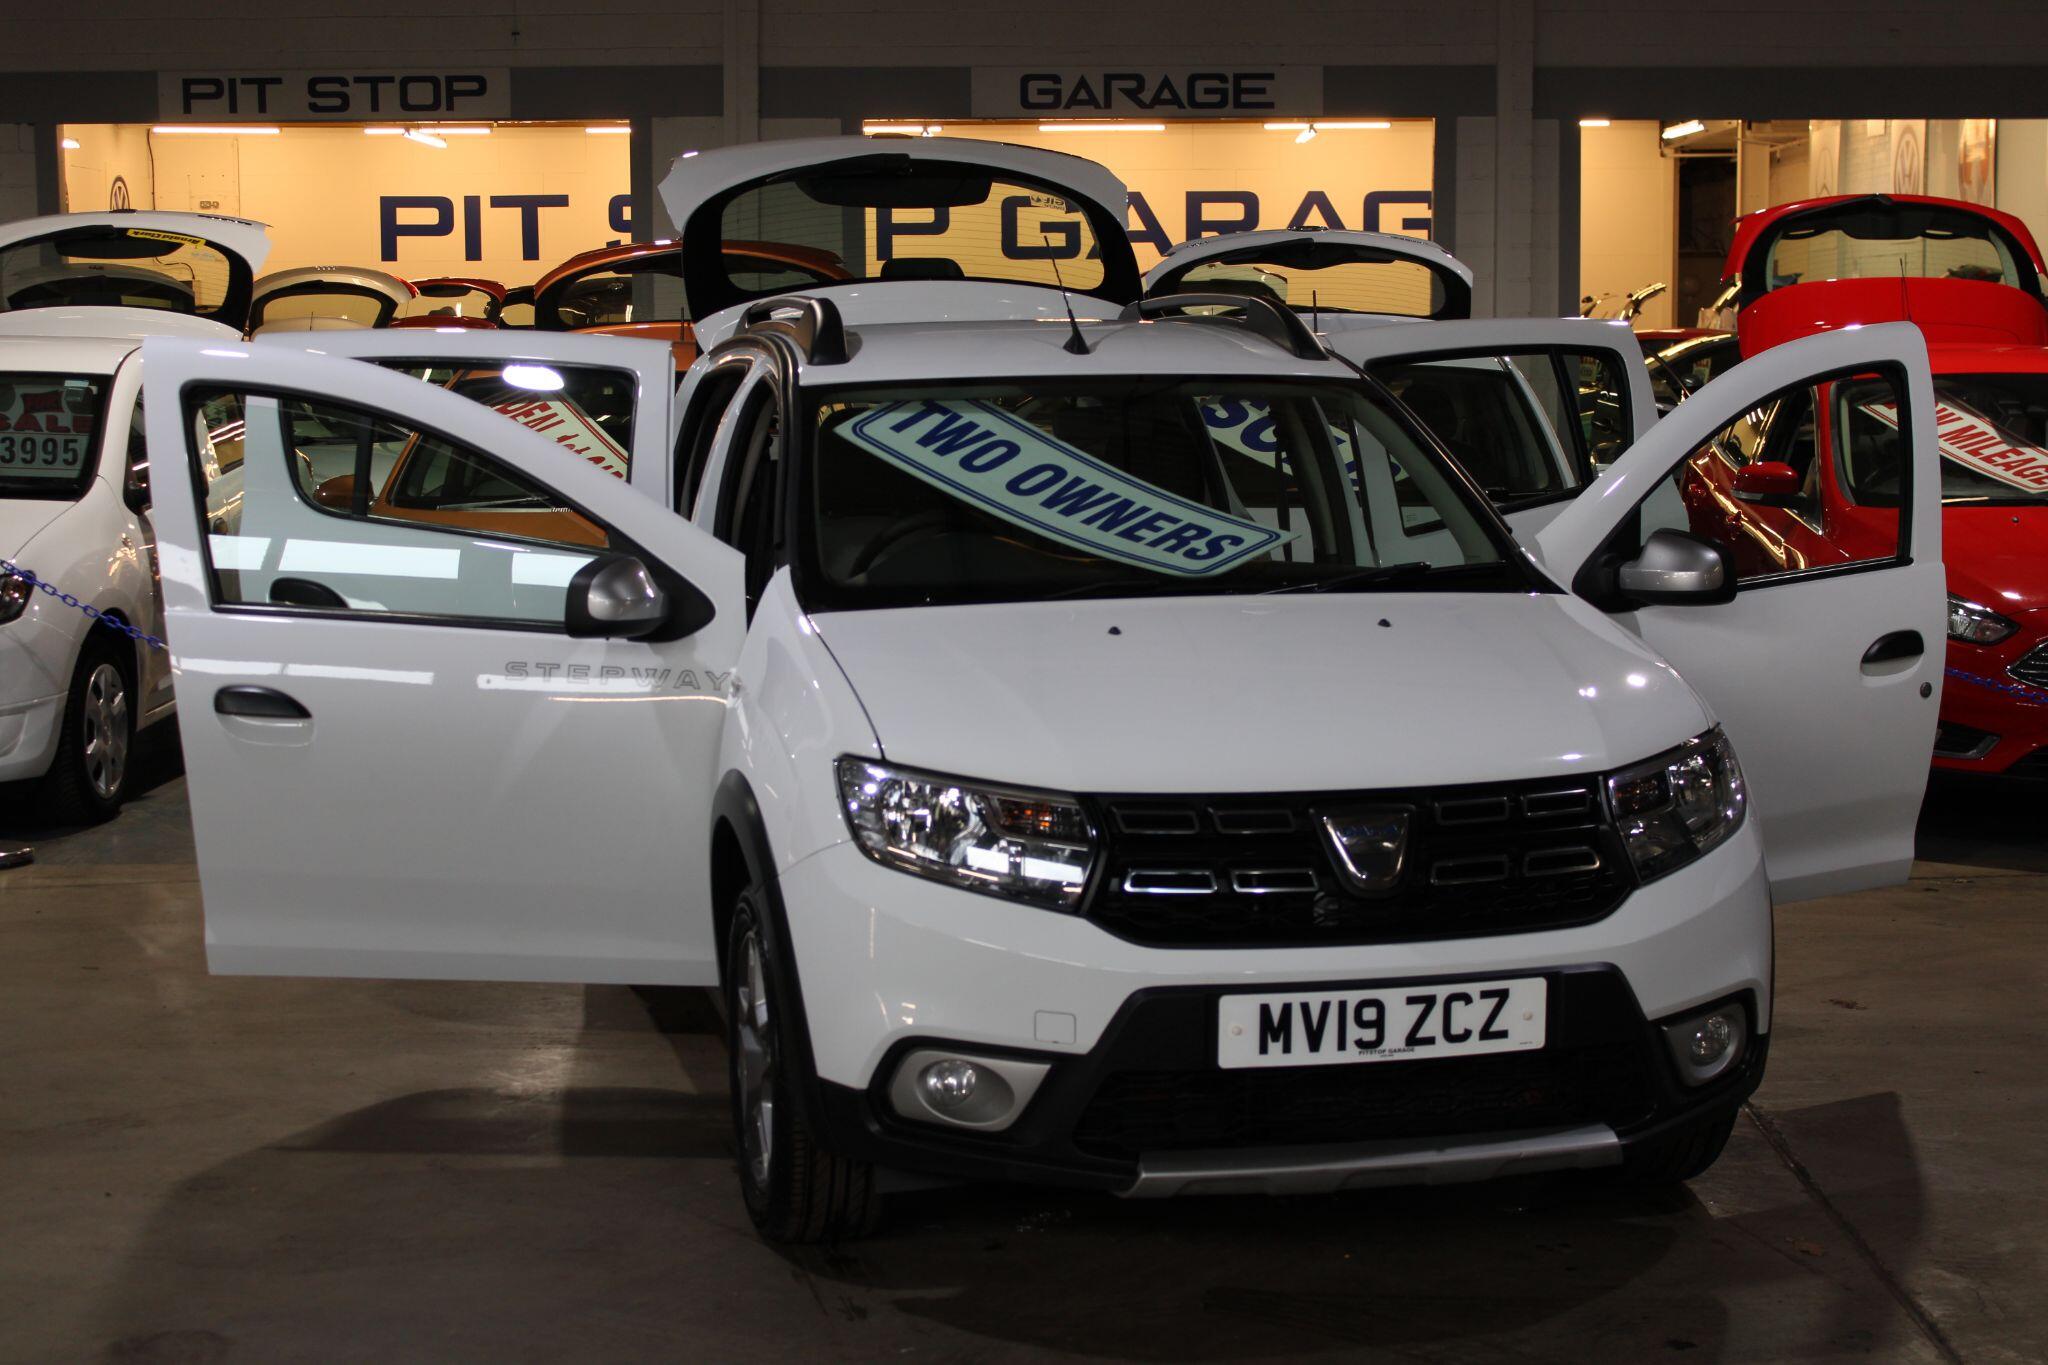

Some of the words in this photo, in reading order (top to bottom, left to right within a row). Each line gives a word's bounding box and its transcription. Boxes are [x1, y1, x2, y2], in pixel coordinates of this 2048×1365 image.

[182, 77, 282, 114] PIT
[307, 75, 487, 113] STOP
[1019, 72, 1275, 110] GARAGE
[380, 194, 569, 262] PIT
[0, 437, 79, 466] 3995
[889, 400, 1021, 474] TWO
[1005, 463, 1245, 560] OWNERS
[504, 661, 731, 691] STEPWAY
[1259, 998, 1386, 1055] MV19
[1404, 988, 1510, 1047] ZCZ
